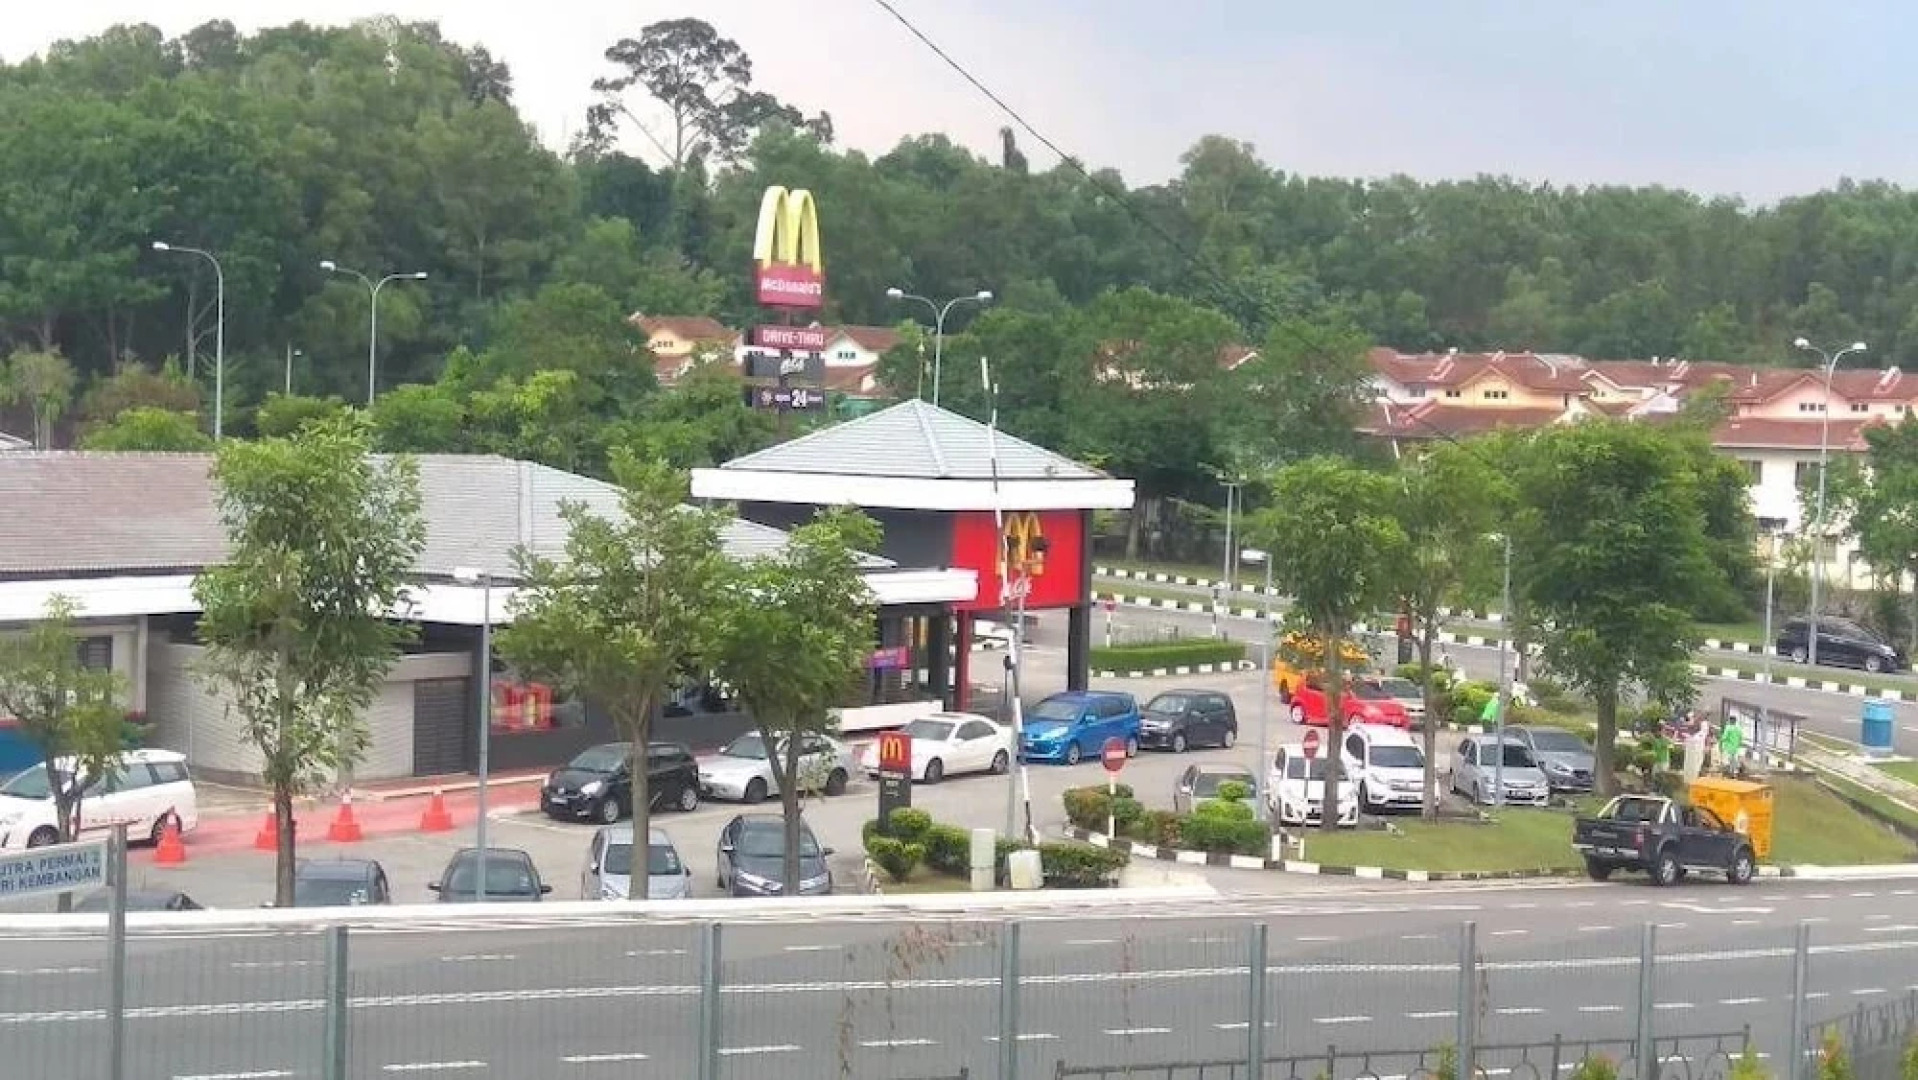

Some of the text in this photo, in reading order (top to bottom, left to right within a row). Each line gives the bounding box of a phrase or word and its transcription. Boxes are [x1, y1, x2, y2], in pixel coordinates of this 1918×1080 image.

[763, 329, 824, 346] DRIVE-THRU
[791, 389, 806, 408] 24
[40, 852, 87, 872] PERMAI
[19, 866, 101, 890] KEMBANGAN
